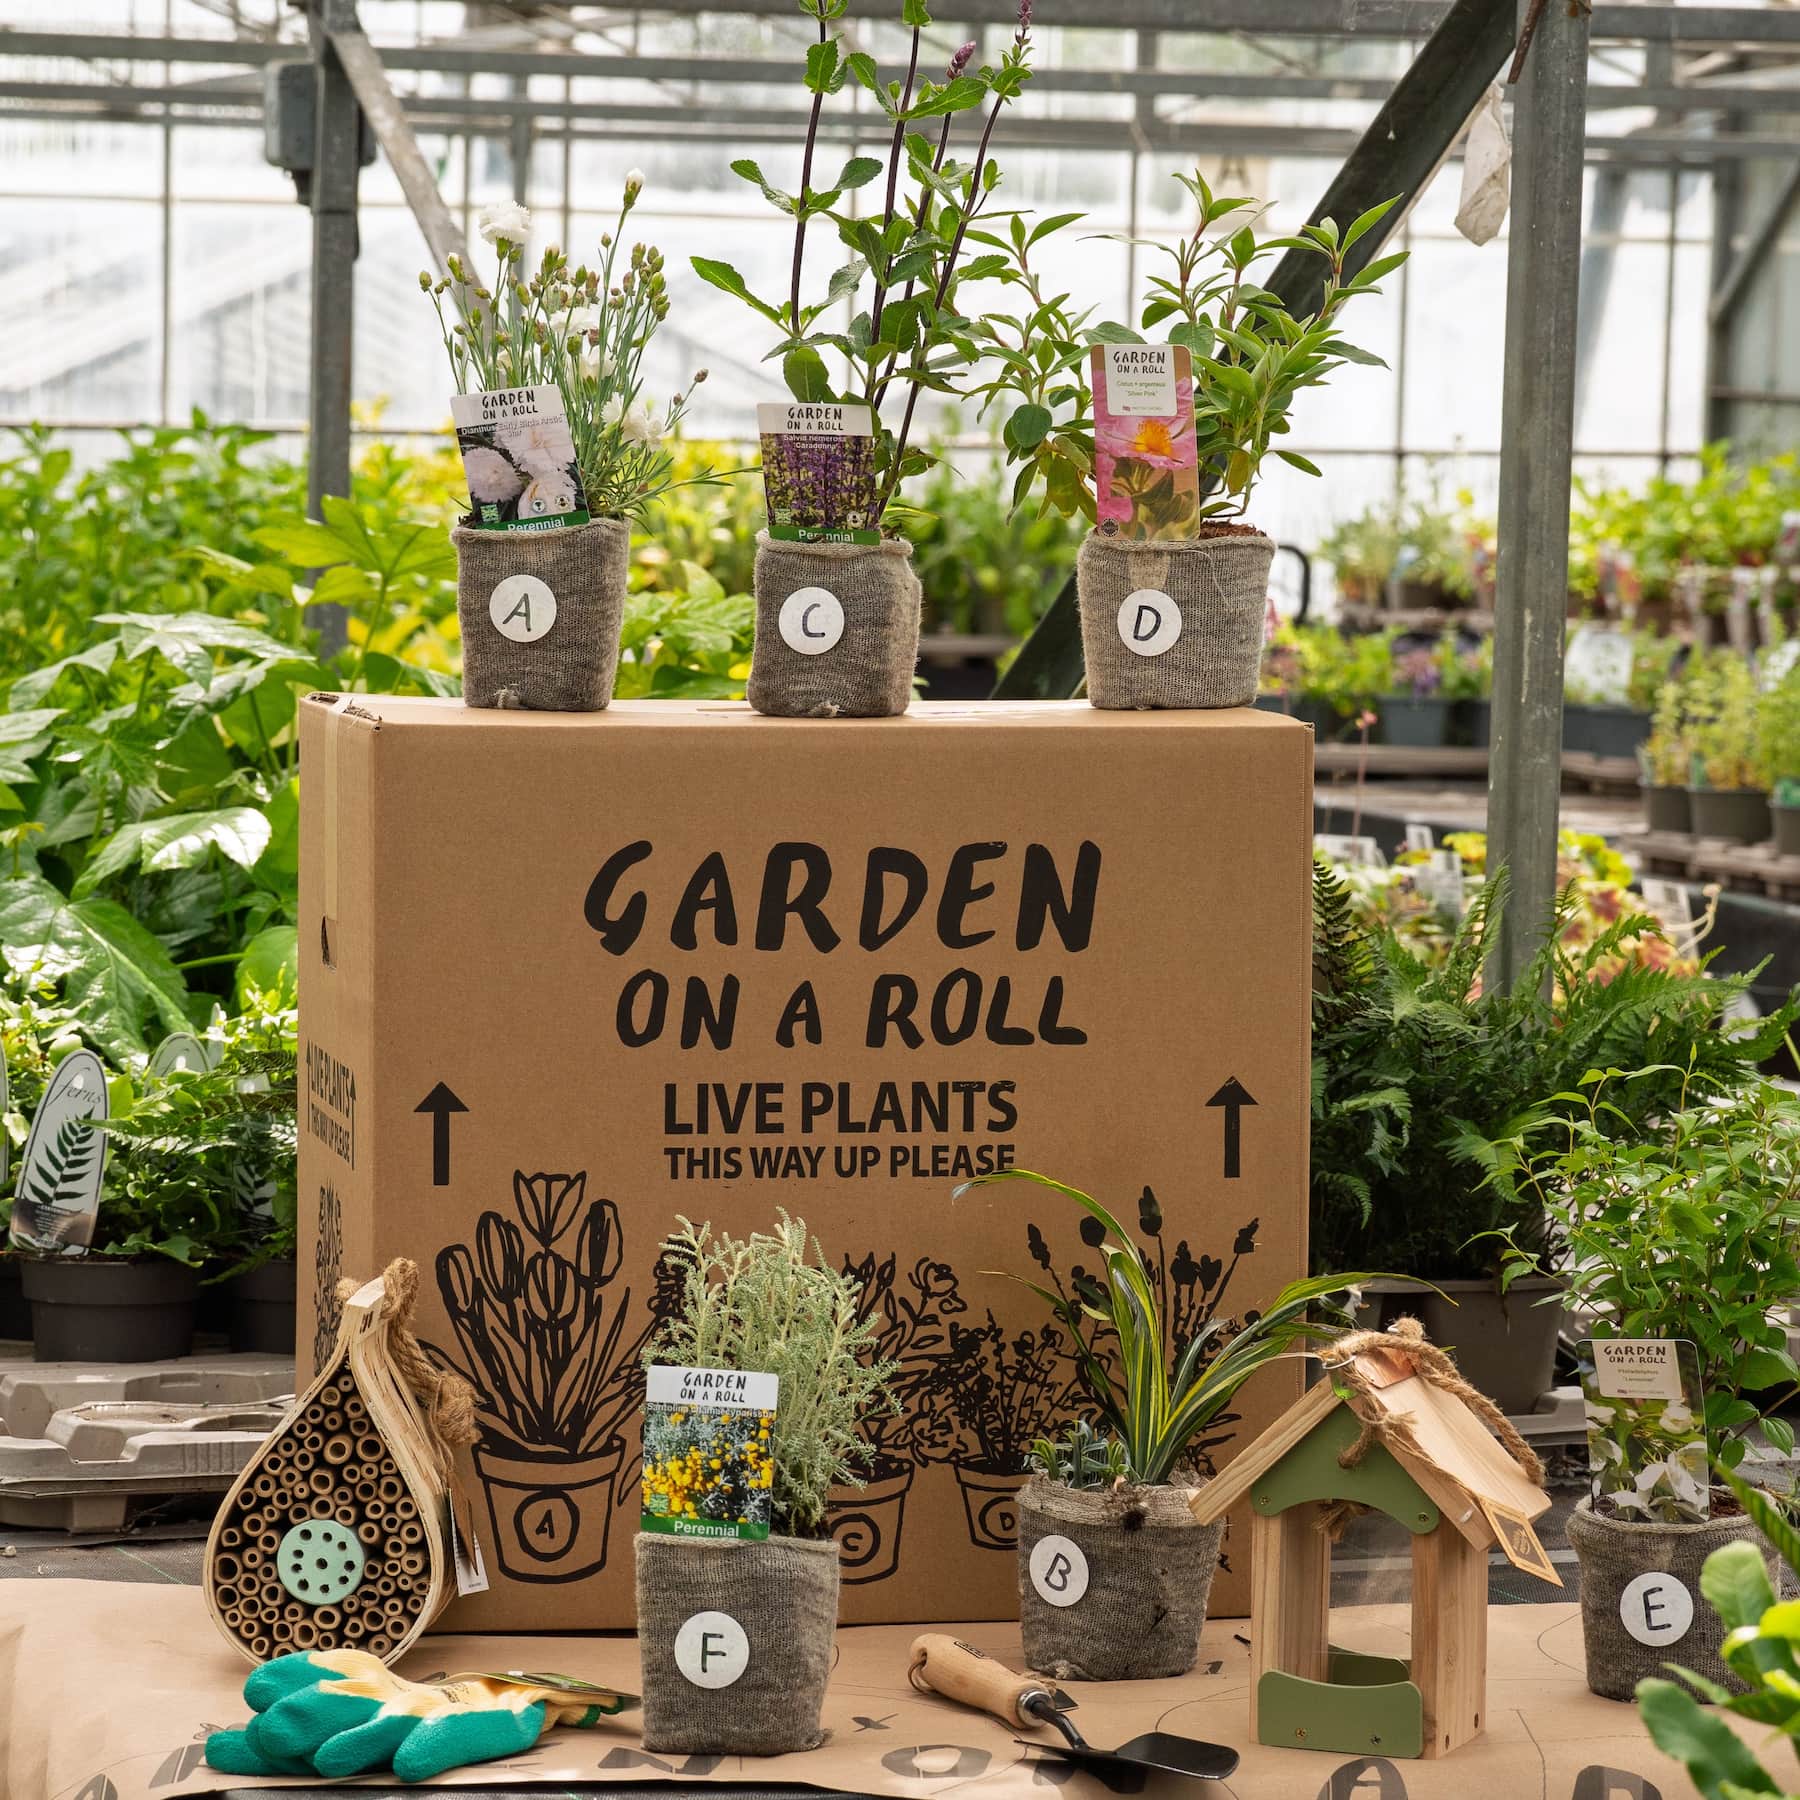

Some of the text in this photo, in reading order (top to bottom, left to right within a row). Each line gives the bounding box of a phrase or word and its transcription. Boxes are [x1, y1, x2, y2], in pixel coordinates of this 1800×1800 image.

[1113, 351, 1165, 364] GARDEN
[1117, 364, 1165, 374] ON A ROLL
[482, 389, 535, 408] GARDEN
[483, 404, 539, 420] ON A ROLL
[788, 407, 842, 420] GARDEN
[787, 420, 844, 431] ON A ROLL
[507, 516, 565, 531] Perennial
[503, 593, 531, 632] A
[802, 603, 826, 638] C
[1133, 605, 1162, 642] D
[583, 839, 1102, 956] GARDEN
[615, 967, 1088, 1050] ON A ROLL
[663, 1079, 1019, 1135] LIVE PLANTS
[663, 1143, 1016, 1180] THIS WAY UP PLEASE
[1603, 1346, 1666, 1356] GARDEN
[1640, 1356, 1667, 1364] ROLL
[683, 1371, 747, 1390] GARDEN
[680, 1387, 745, 1403] ON A ROLL
[535, 1509, 555, 1539] A
[674, 1521, 739, 1537] Perennial
[1000, 1512, 1016, 1531] D
[842, 1532, 863, 1551] C
[1044, 1552, 1072, 1592] B
[1643, 1586, 1672, 1631] E
[701, 1632, 727, 1673] F
